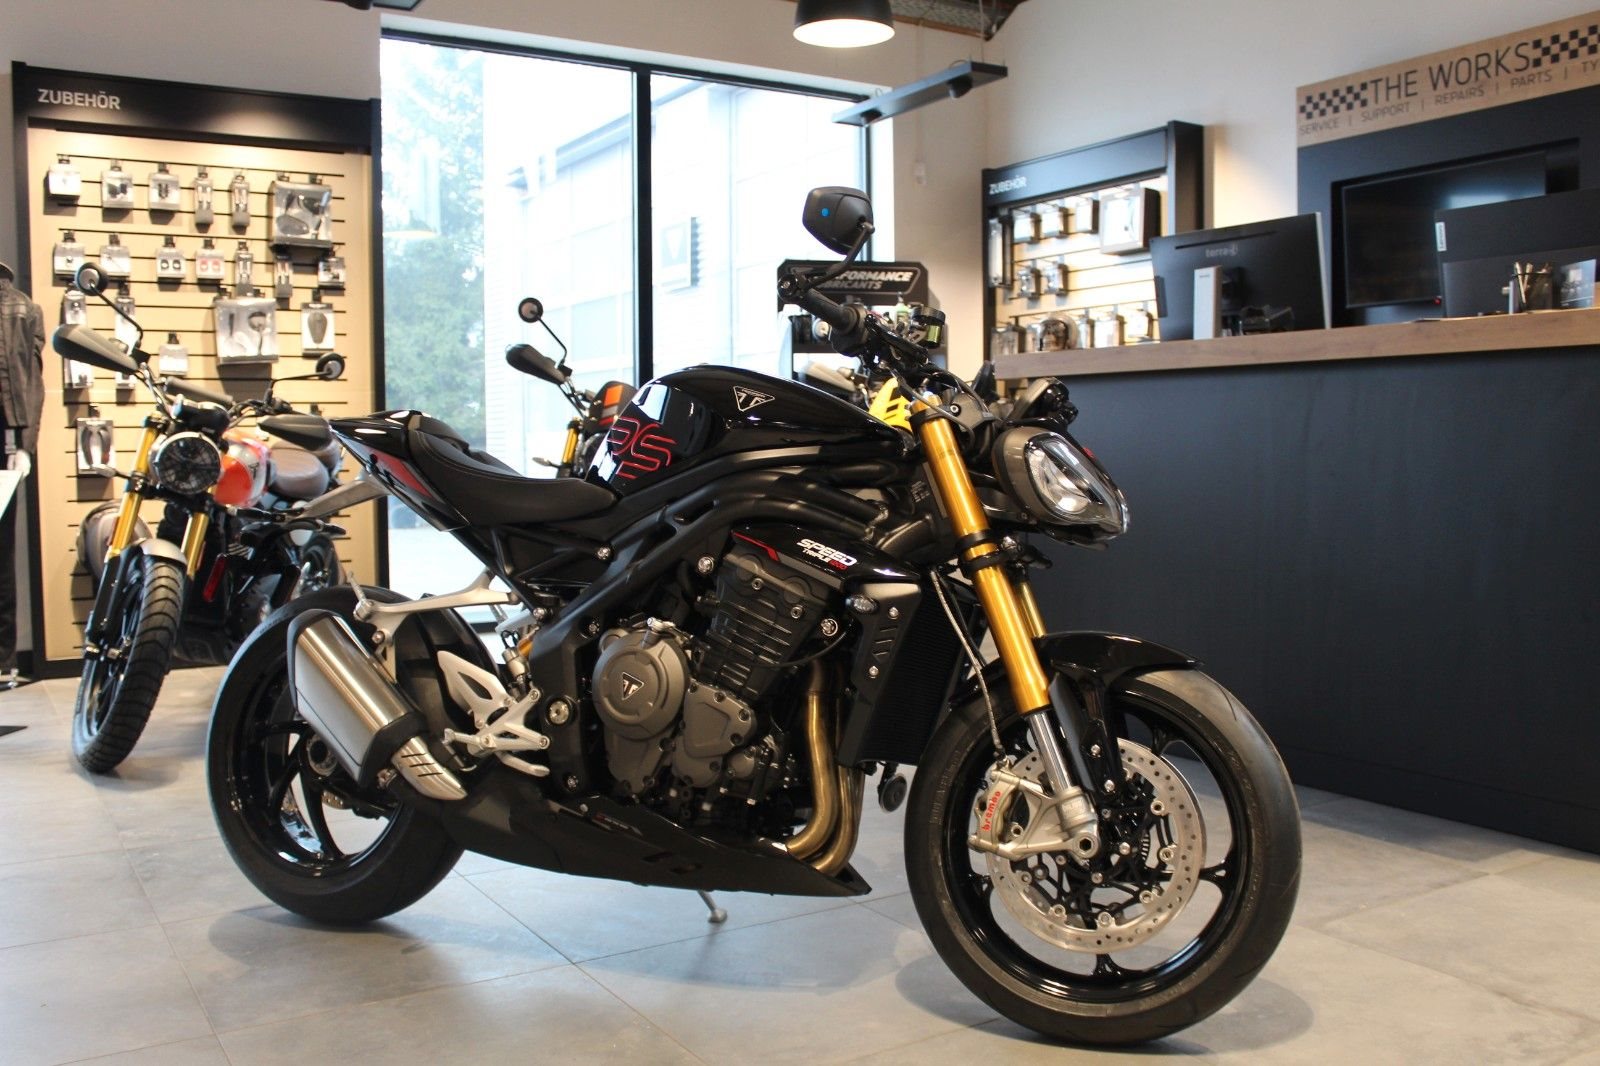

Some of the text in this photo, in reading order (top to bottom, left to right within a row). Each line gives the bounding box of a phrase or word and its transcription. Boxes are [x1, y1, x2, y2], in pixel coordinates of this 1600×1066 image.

[1370, 42, 1530, 104] THE WORKS
[37, 88, 121, 110] ZUBEHÖR
[1299, 117, 1339, 135] SERVICE
[1361, 102, 1410, 121] SUPPORT
[1434, 84, 1485, 105] REPAIRS
[1511, 69, 1553, 89] PARTS
[796, 538, 858, 567] SPEED
[802, 547, 832, 563] TRIPLE
[981, 791, 1002, 831] brembo
